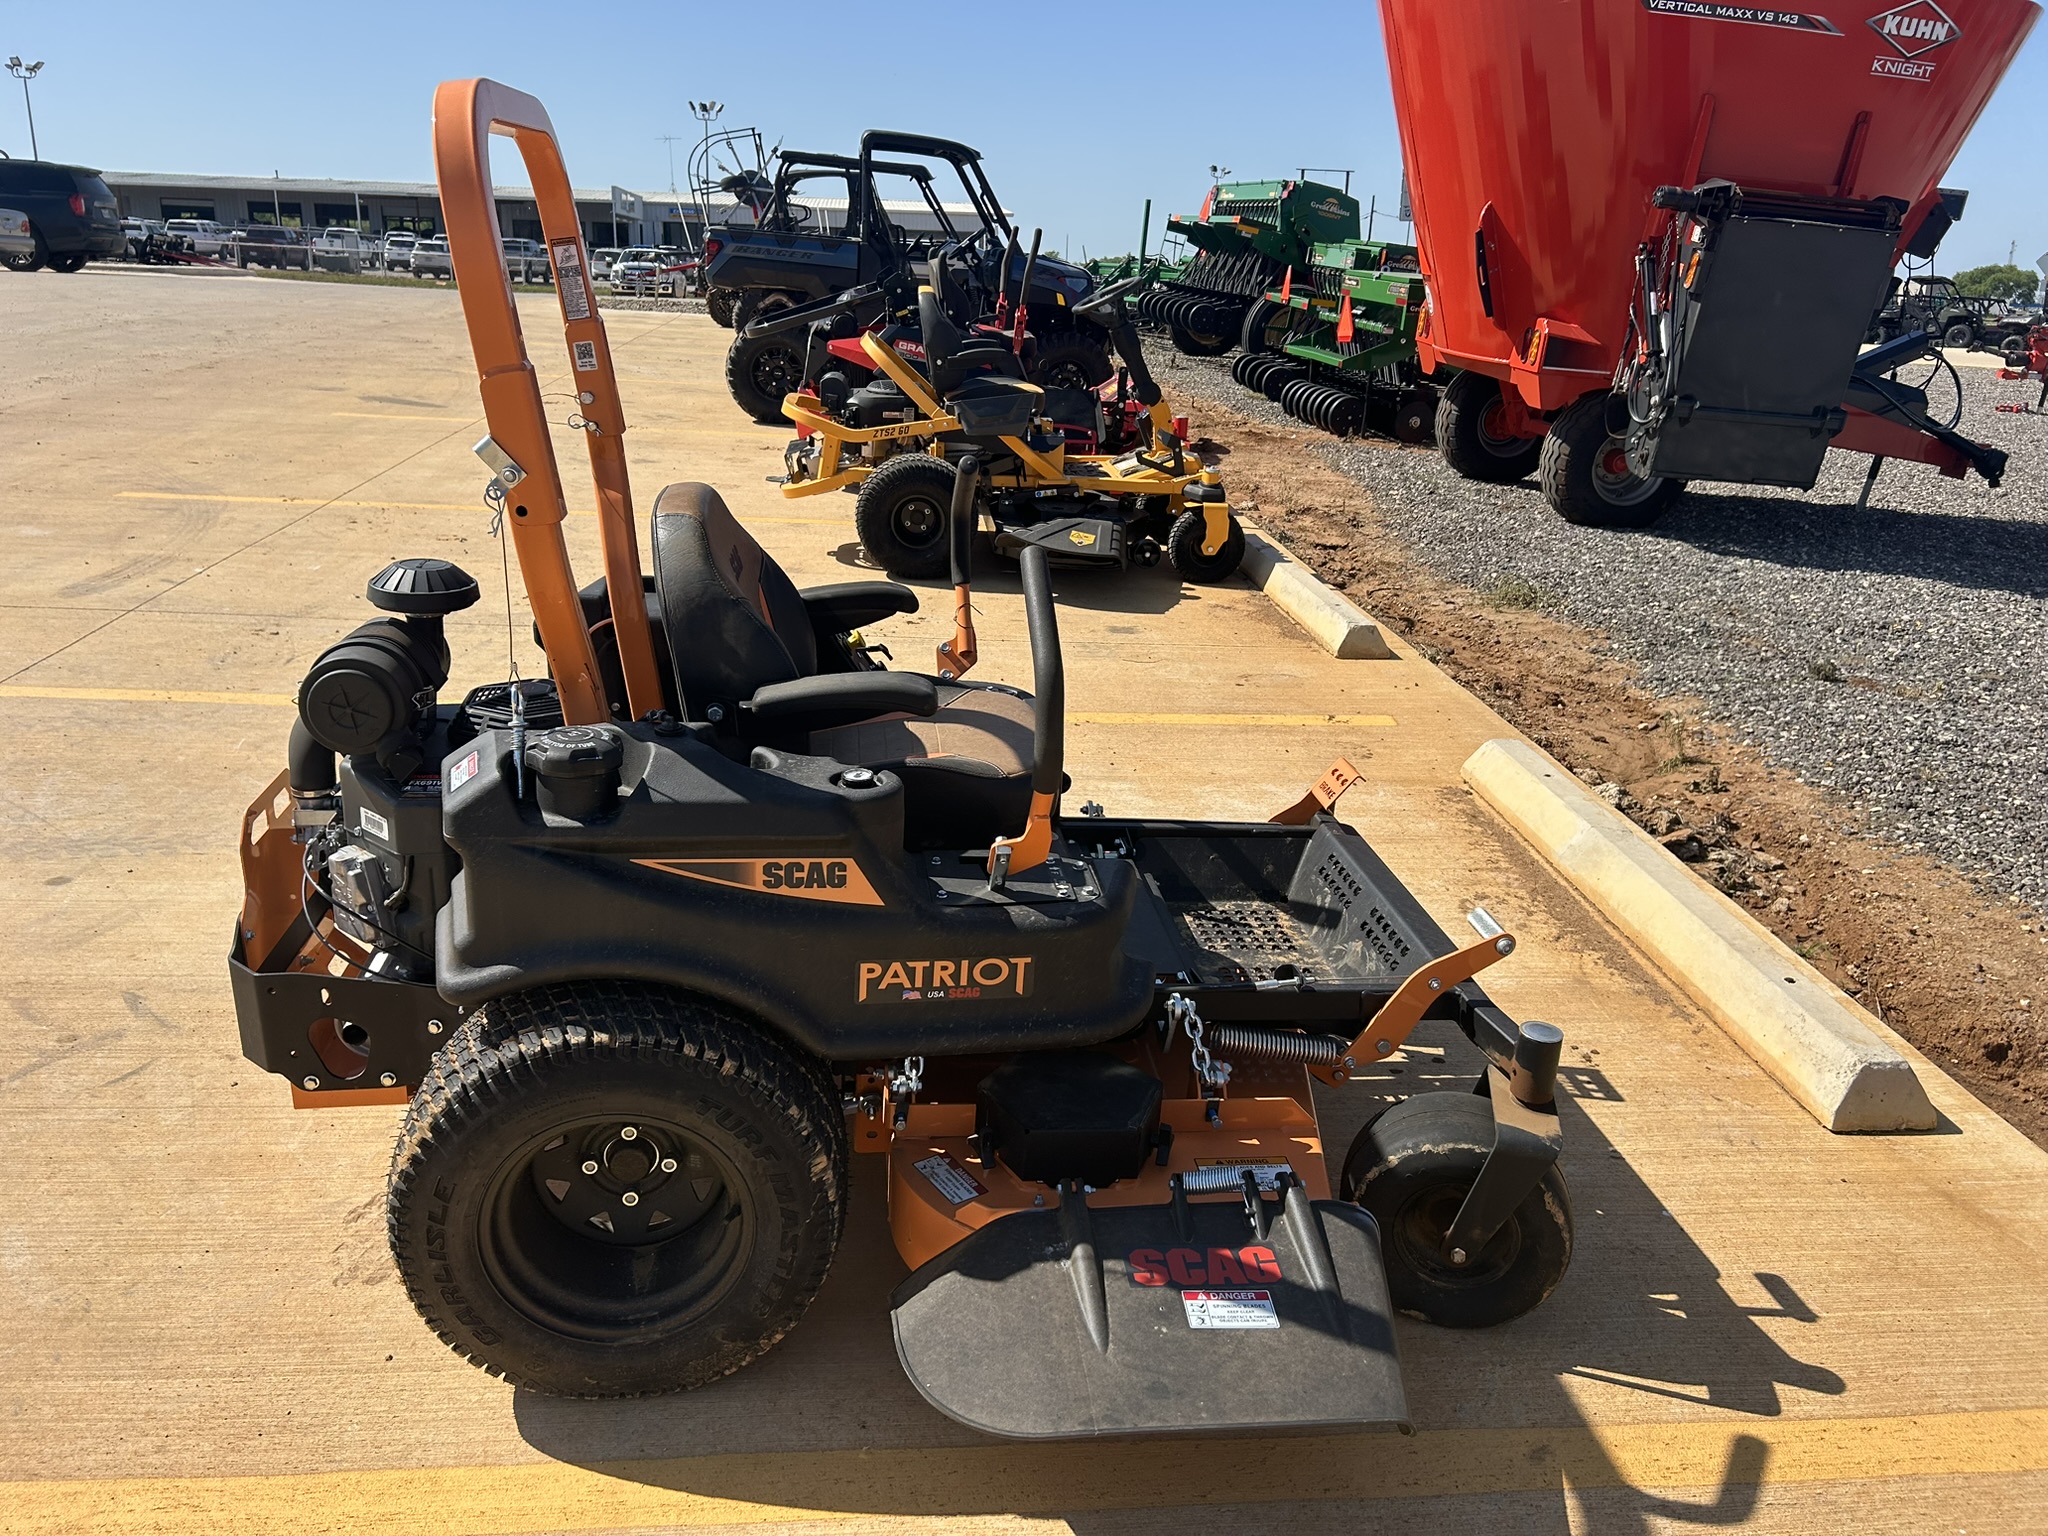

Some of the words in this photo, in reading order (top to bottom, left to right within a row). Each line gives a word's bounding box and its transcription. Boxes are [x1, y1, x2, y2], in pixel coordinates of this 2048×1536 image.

[1650, 0, 1712, 14] VERTICAL
[1715, 6, 1754, 19] MAXX
[1757, 11, 1774, 21] VS
[1777, 13, 1799, 24] 143
[1882, 14, 1950, 41] KUHN
[1871, 59, 1935, 78] KNIGHT
[731, 245, 815, 260] RANGER
[1319, 781, 1336, 800] BRAKE
[762, 861, 847, 889] SCAG
[858, 957, 1032, 1003] PATRIOT
[927, 990, 945, 998] USA
[948, 986, 981, 998] SCAG
[695, 1094, 782, 1162] TURF
[954, 1167, 980, 1188] DANGER
[424, 1175, 504, 1347] CARLISLE
[1129, 1245, 1283, 1287] SCAG
[1210, 1292, 1256, 1300] DANGER
